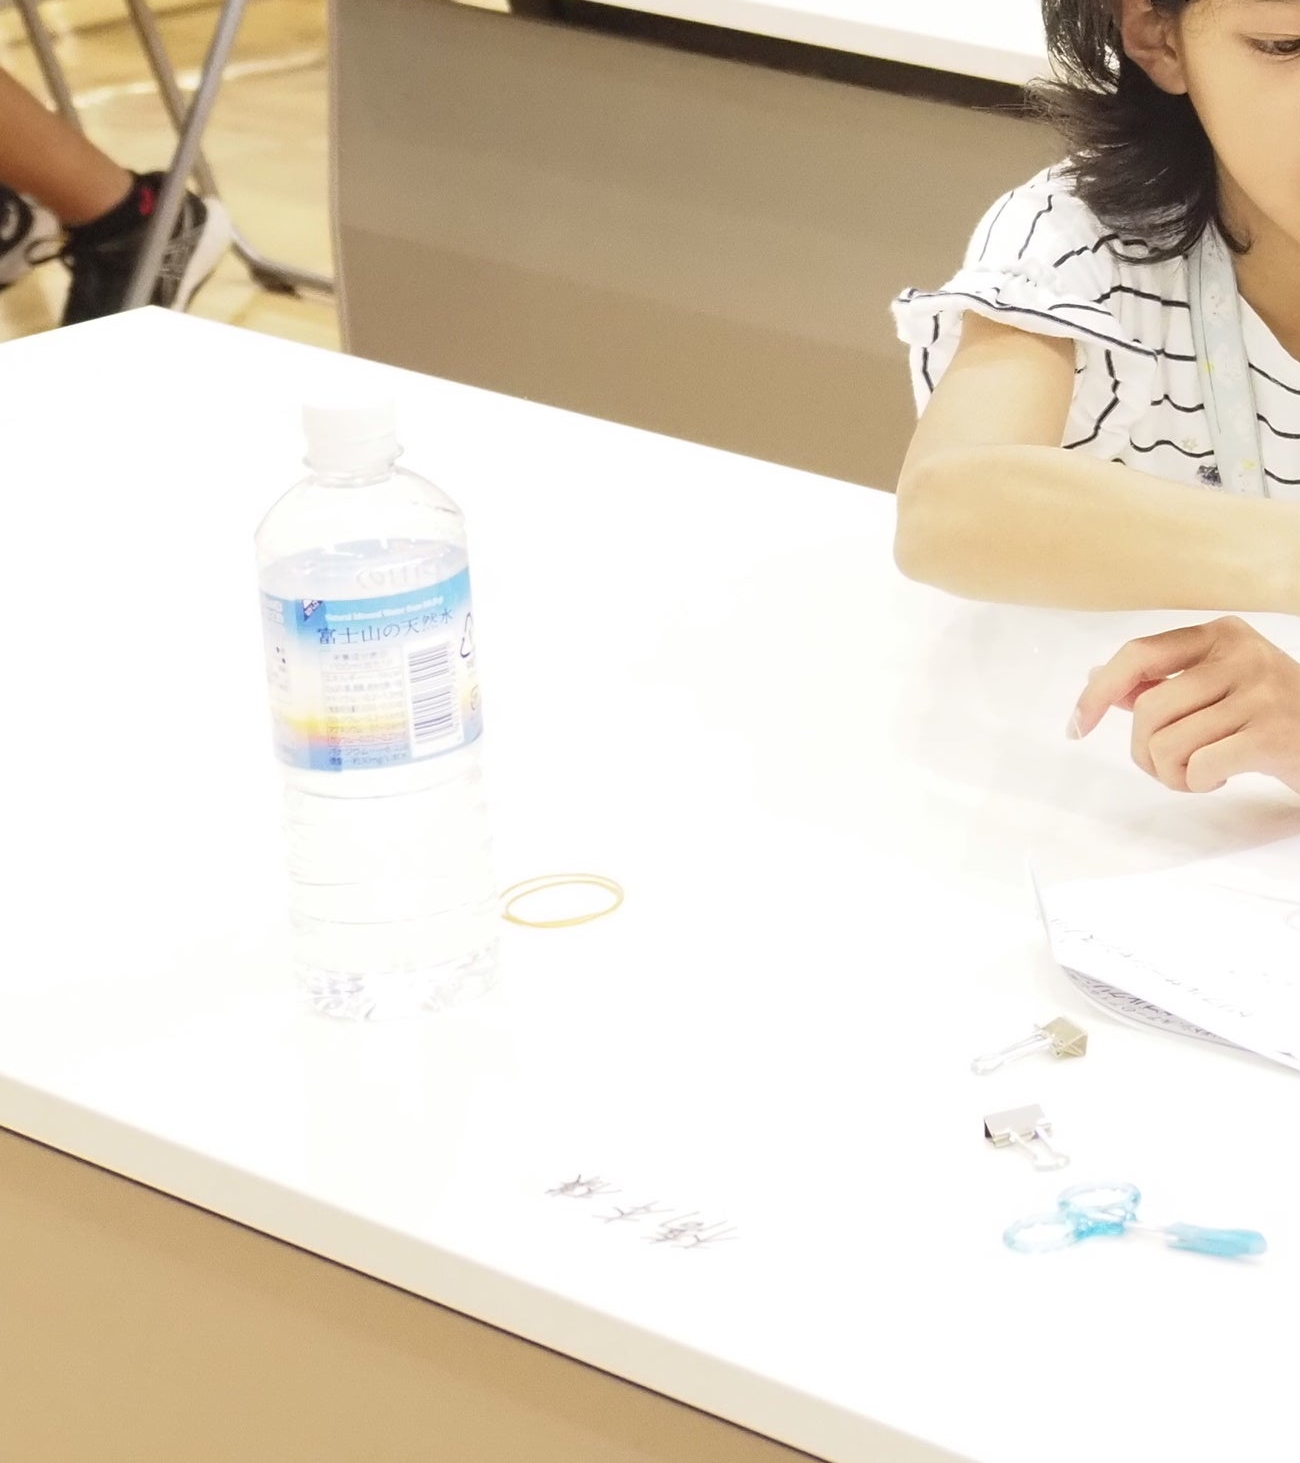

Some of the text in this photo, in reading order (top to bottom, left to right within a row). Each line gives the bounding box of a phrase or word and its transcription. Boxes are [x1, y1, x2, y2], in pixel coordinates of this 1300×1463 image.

[317, 607, 453, 645] 富士山の天然水
